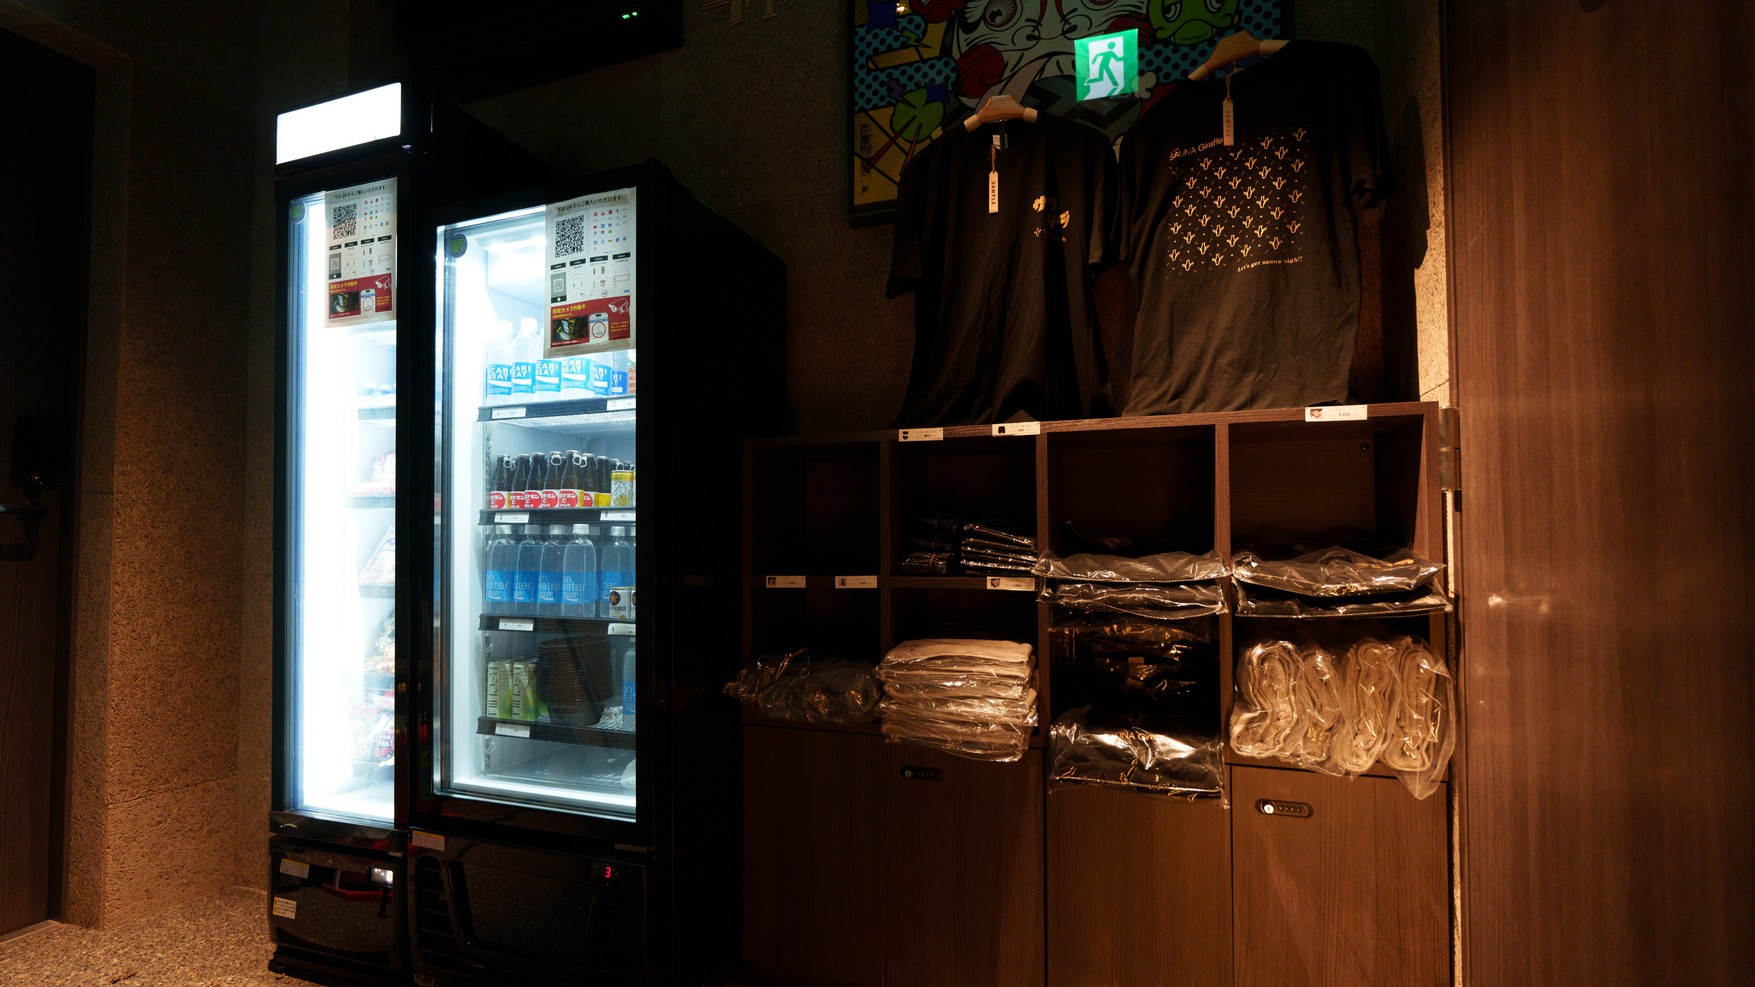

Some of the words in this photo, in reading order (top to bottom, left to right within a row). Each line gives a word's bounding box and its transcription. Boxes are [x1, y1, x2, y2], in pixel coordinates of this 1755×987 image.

[1169, 147, 1197, 161] SAUNA
[1197, 137, 1224, 152] Giraffe
[1250, 261, 1261, 269] get
[605, 865, 611, 879] 3
